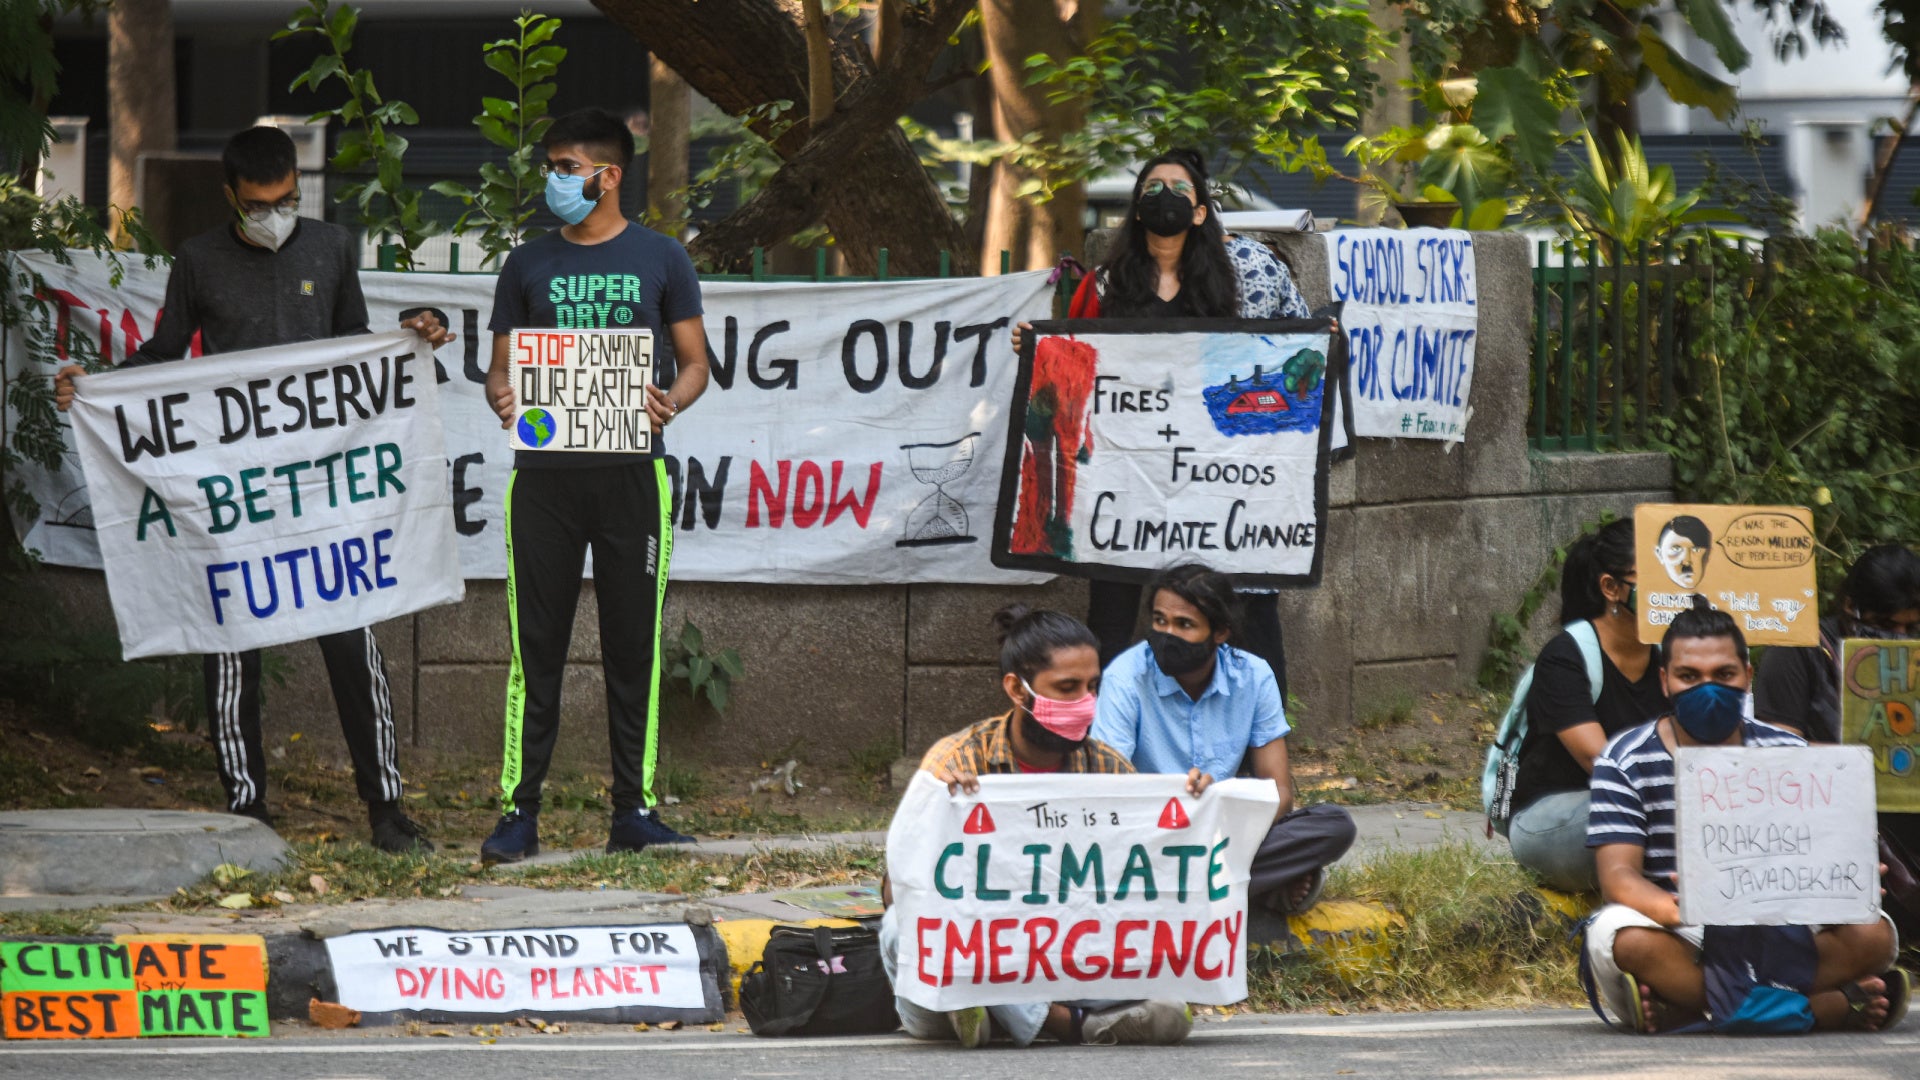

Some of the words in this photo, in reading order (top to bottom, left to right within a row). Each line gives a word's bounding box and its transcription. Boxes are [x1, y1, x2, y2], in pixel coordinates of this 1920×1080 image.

[549, 274, 641, 304] SUPER
[1335, 235, 1411, 305] SCHOOL
[517, 332, 576, 366] STOP
[579, 333, 651, 367] DENYING
[842, 317, 1008, 394] OUT
[1349, 324, 1384, 401] FOR
[521, 367, 567, 406] OUR
[574, 368, 645, 407] EARTH
[1094, 375, 1171, 414] FIRES
[115, 392, 197, 463] WE
[215, 352, 416, 444] DESERVE
[564, 408, 588, 449] IS
[594, 408, 649, 450] DYING
[1172, 446, 1276, 486] FLOODS
[137, 486, 178, 541] A
[198, 442, 406, 534] BETTER
[745, 459, 884, 530] NOW
[1090, 491, 1219, 551] CLIMATE
[1224, 499, 1316, 550] CHANGE
[1745, 520, 1764, 529] WAS
[1771, 520, 1789, 529] THE
[646, 534, 658, 577] NIKE
[1727, 536, 1765, 547] REASON
[1768, 536, 1811, 549] MILLIONS
[1749, 551, 1780, 561] PEOPLE
[206, 528, 398, 625] FUTURE
[1649, 592, 1705, 608] CLIMAT
[1026, 802, 1067, 829] This
[1083, 808, 1097, 826] is
[1111, 811, 1120, 826] a
[1701, 821, 1812, 858] PRAKASH
[934, 836, 1231, 905] CLIMATE
[17, 944, 226, 980] CLIMATE
[374, 936, 423, 958] WE
[448, 934, 579, 958] STAND
[610, 931, 679, 955] FOR
[917, 910, 1243, 988] EMERGENCY
[136, 980, 152, 993] IS
[161, 981, 186, 993] MY
[395, 965, 506, 1000] DYING
[531, 964, 668, 999] PLANET
[15, 993, 121, 1035] BEST
[142, 992, 259, 1032] MATE
